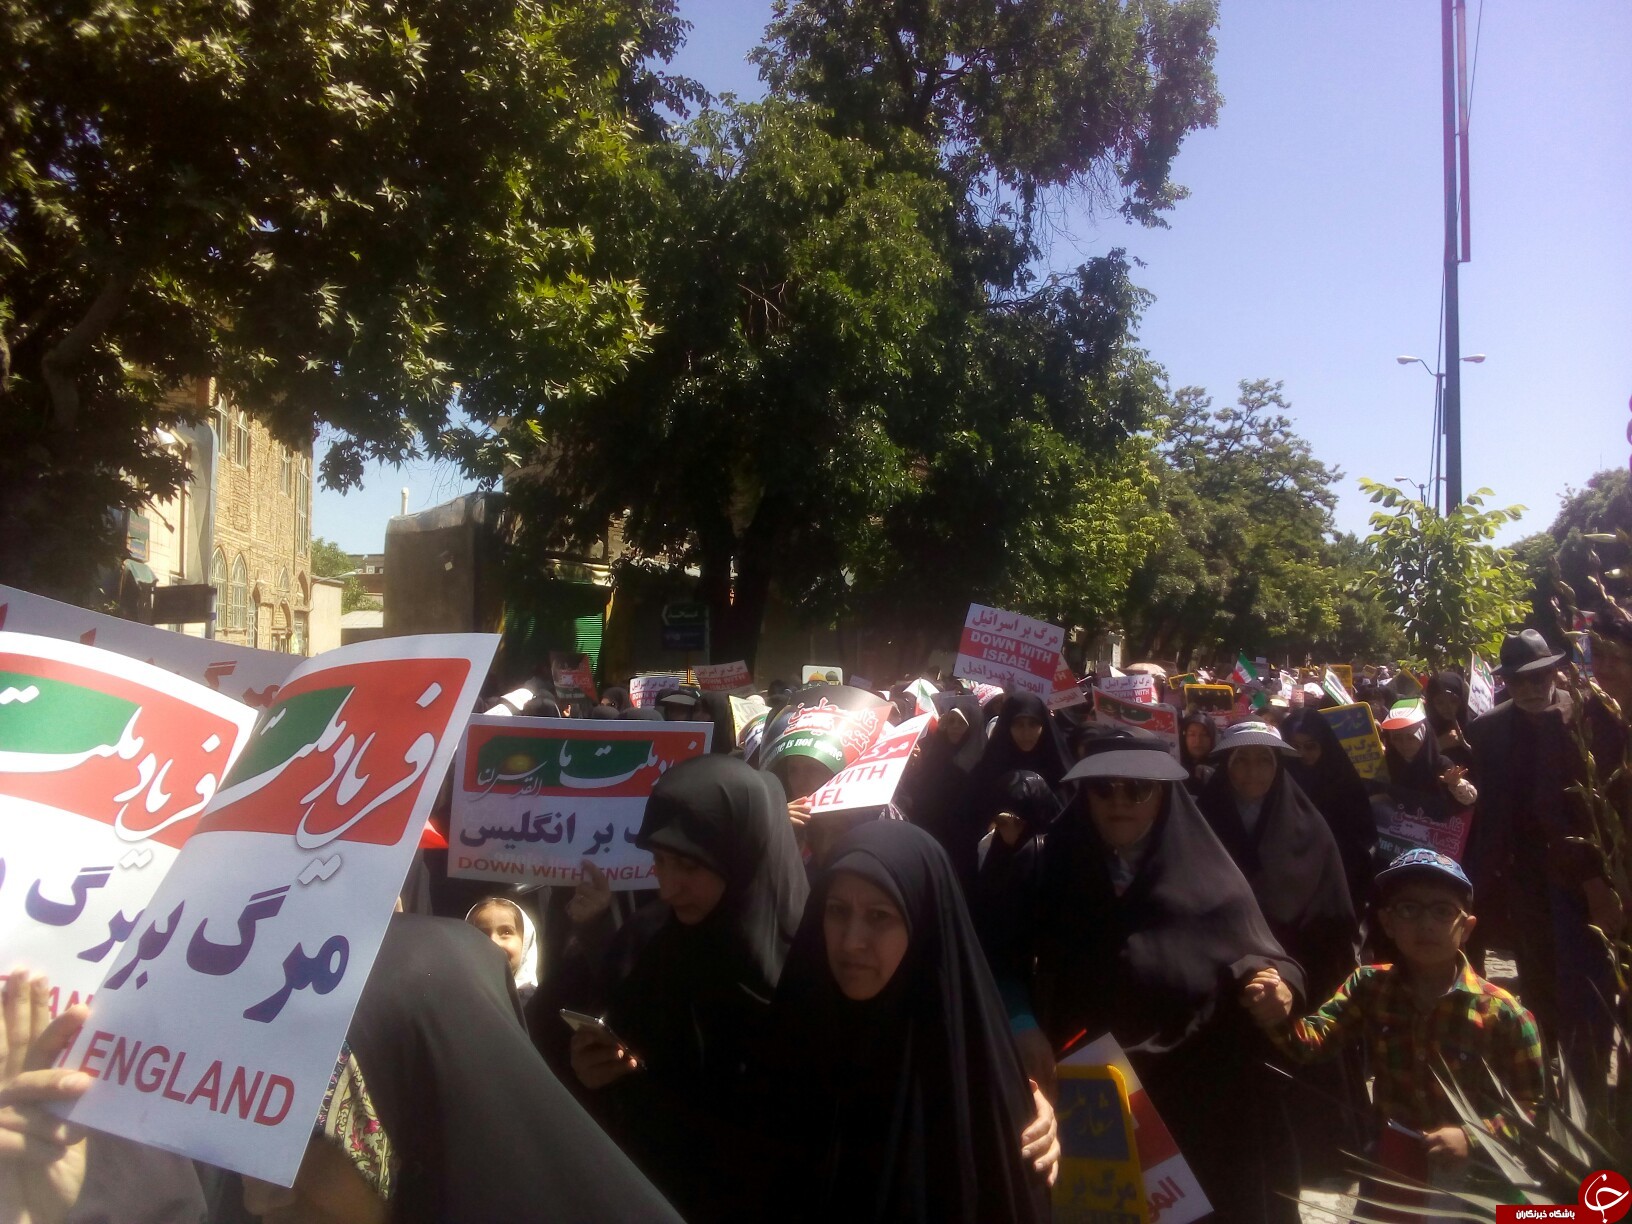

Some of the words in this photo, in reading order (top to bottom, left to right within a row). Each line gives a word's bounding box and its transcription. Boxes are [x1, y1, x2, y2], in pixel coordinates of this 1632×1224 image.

[970, 630, 1016, 652] DOWN
[1020, 641, 1053, 664] WITH
[1020, 626, 1032, 640] بر
[1033, 627, 1059, 647] مرگ
[982, 648, 1032, 672] ISRAEL
[1134, 689, 1150, 697] WITH
[558, 739, 573, 768] ما
[559, 739, 659, 789] ملت
[296, 681, 443, 886] فریاد
[826, 764, 888, 787] WITH
[459, 810, 576, 851] انگلیس
[582, 821, 615, 856] بر
[457, 857, 525, 875] DOWN
[533, 864, 585, 881] WITH
[104, 899, 186, 991] بر
[186, 884, 350, 1024] مرگ
[83, 1030, 296, 1127] ENGLAND
[1148, 1175, 1186, 1223] المو
